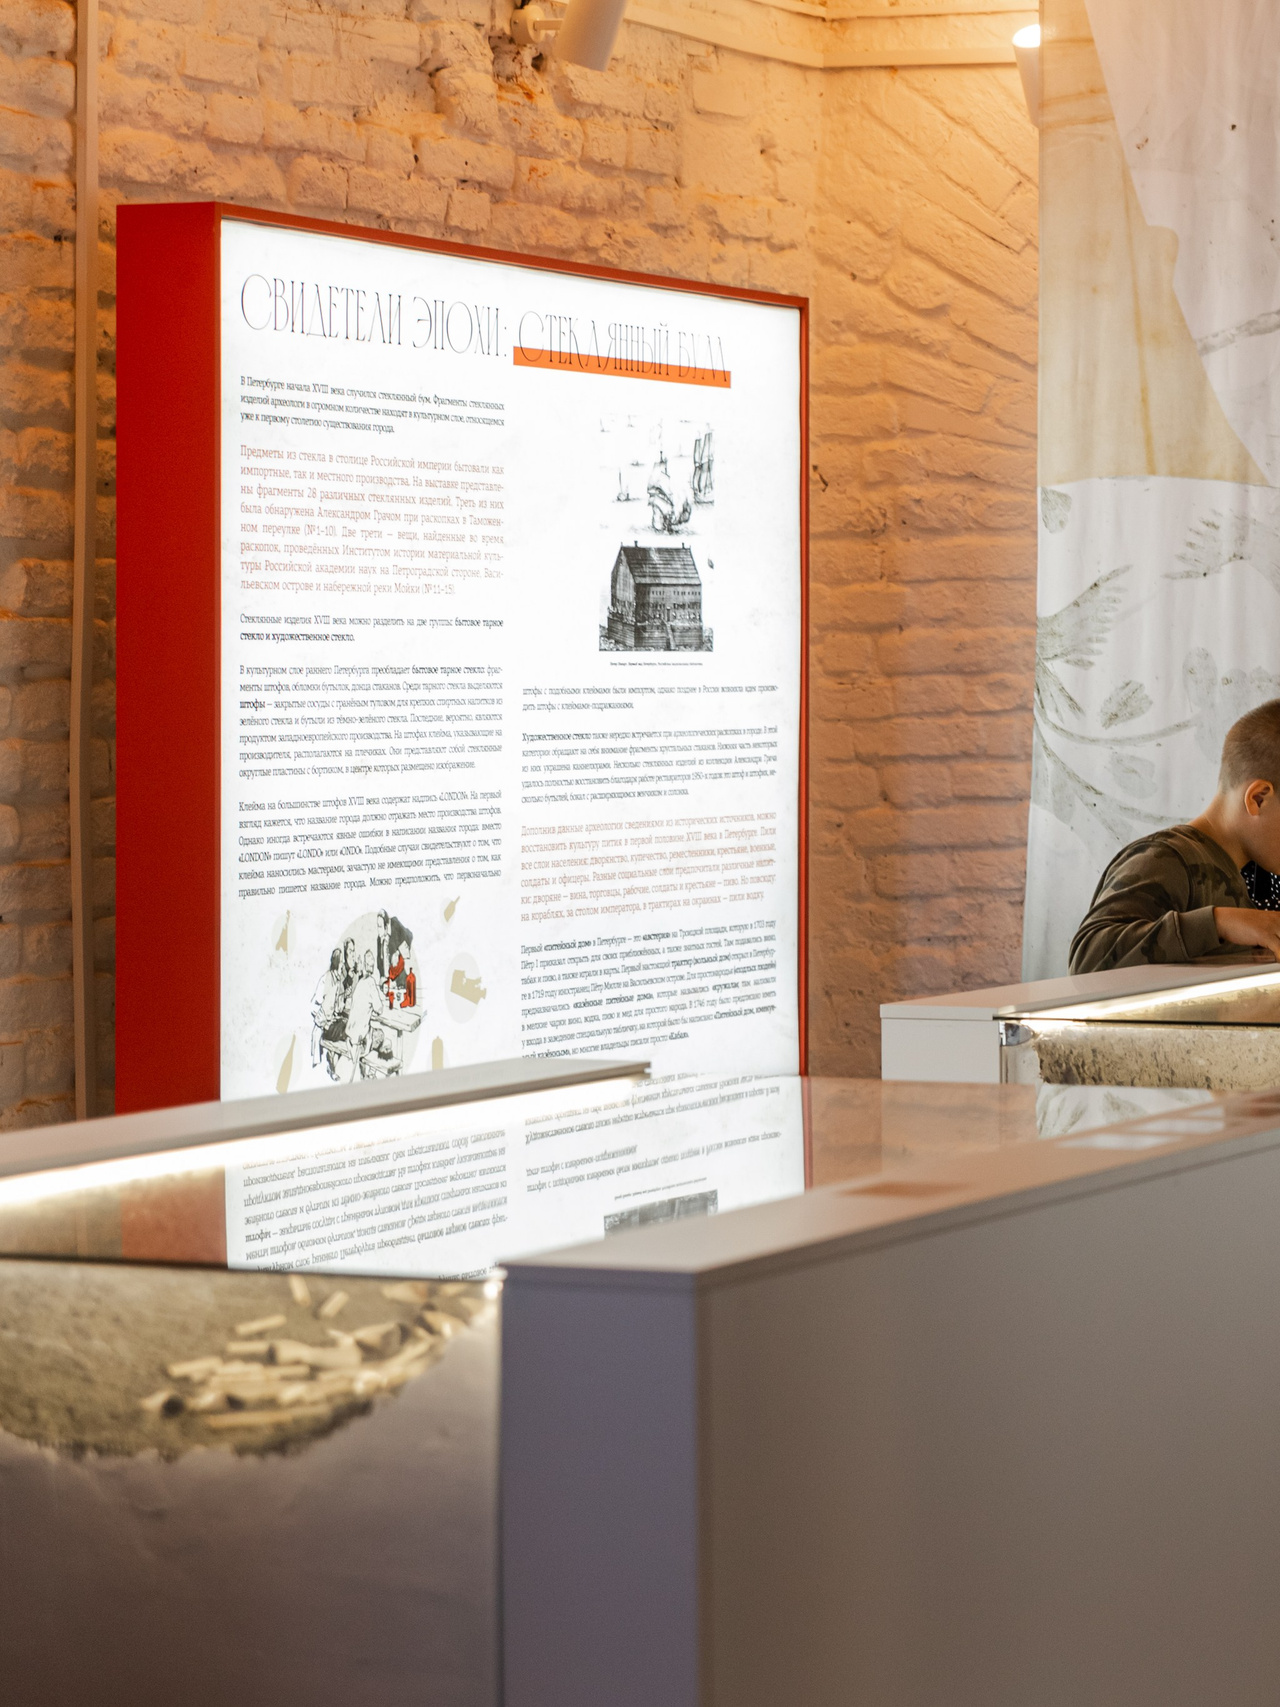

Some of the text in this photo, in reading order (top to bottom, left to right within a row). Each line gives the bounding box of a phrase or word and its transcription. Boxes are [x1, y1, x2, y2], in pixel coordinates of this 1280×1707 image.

[241, 273, 728, 383] СВИДЕТЕЛИ ЭПОХИ: СТЕКЛЯННЫЙ БУМ
[240, 444, 504, 474] Предметы из стекла в столице Российской империи бытовали как
[293, 470, 307, 479] так
[308, 471, 314, 479] и
[316, 472, 354, 482] местного
[412, 475, 422, 487] На
[424, 479, 458, 489] выставке
[240, 485, 253, 494] ны
[256, 483, 304, 498] фрагменты
[307, 486, 317, 498] 28
[319, 490, 365, 502] различных
[367, 493, 416, 504] стеклянных
[456, 496, 476, 510] Треть
[478, 500, 487, 508] из
[489, 500, 504, 509] них
[239, 501, 262, 514] была
[264, 503, 314, 518] обнаружена
[373, 509, 401, 523] Грачом
[403, 513, 418, 525] при
[420, 514, 459, 525] раскопках
[462, 516, 466, 524] в
[469, 514, 503, 526] Таможен-
[240, 523, 258, 532] ном
[262, 524, 300, 536] переулке
[341, 525, 356, 537] Две
[360, 529, 382, 541] трети
[422, 530, 465, 542] найденные
[469, 534, 477, 542] во
[481, 535, 504, 546] время
[342, 544, 390, 556] Институтом
[393, 549, 425, 560] истории
[483, 552, 503, 560] куль-
[240, 560, 262, 573] туры
[264, 559, 312, 572] Российской
[314, 564, 355, 574] академии
[358, 565, 376, 574] наук
[379, 566, 389, 575] на
[484, 567, 503, 578] Васи-
[240, 580, 280, 590] льевском
[281, 581, 313, 593] острове
[315, 582, 321, 591] и
[322, 581, 371, 595] набережной
[373, 584, 392, 596] реки
[394, 582, 420, 593] Мойки
